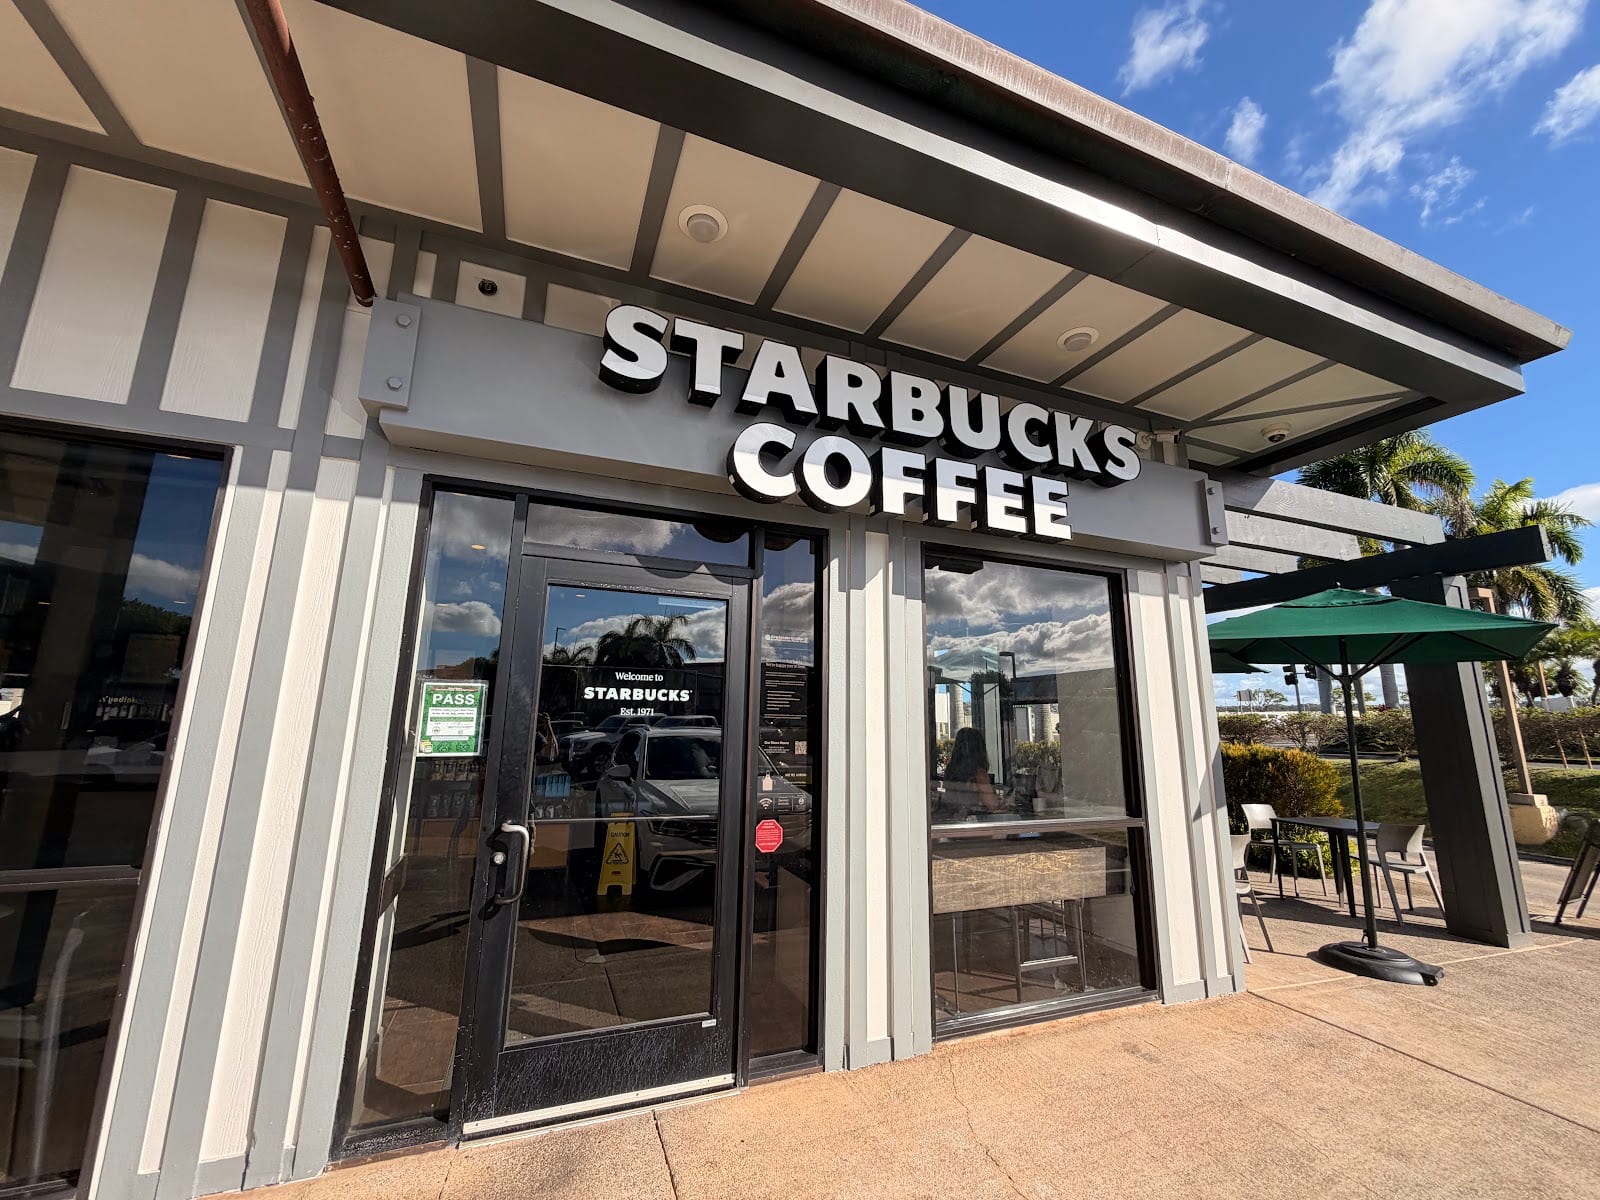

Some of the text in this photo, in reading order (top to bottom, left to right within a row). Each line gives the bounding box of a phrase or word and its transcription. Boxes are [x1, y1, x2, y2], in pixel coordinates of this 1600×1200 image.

[600, 304, 1142, 484] STARBUCKS
[728, 421, 1072, 541] COFFEE
[615, 671, 664, 682] Welcome to
[432, 693, 475, 705] PASS
[583, 686, 690, 701] STARBUCKS
[620, 707, 655, 716] Est. 1971
